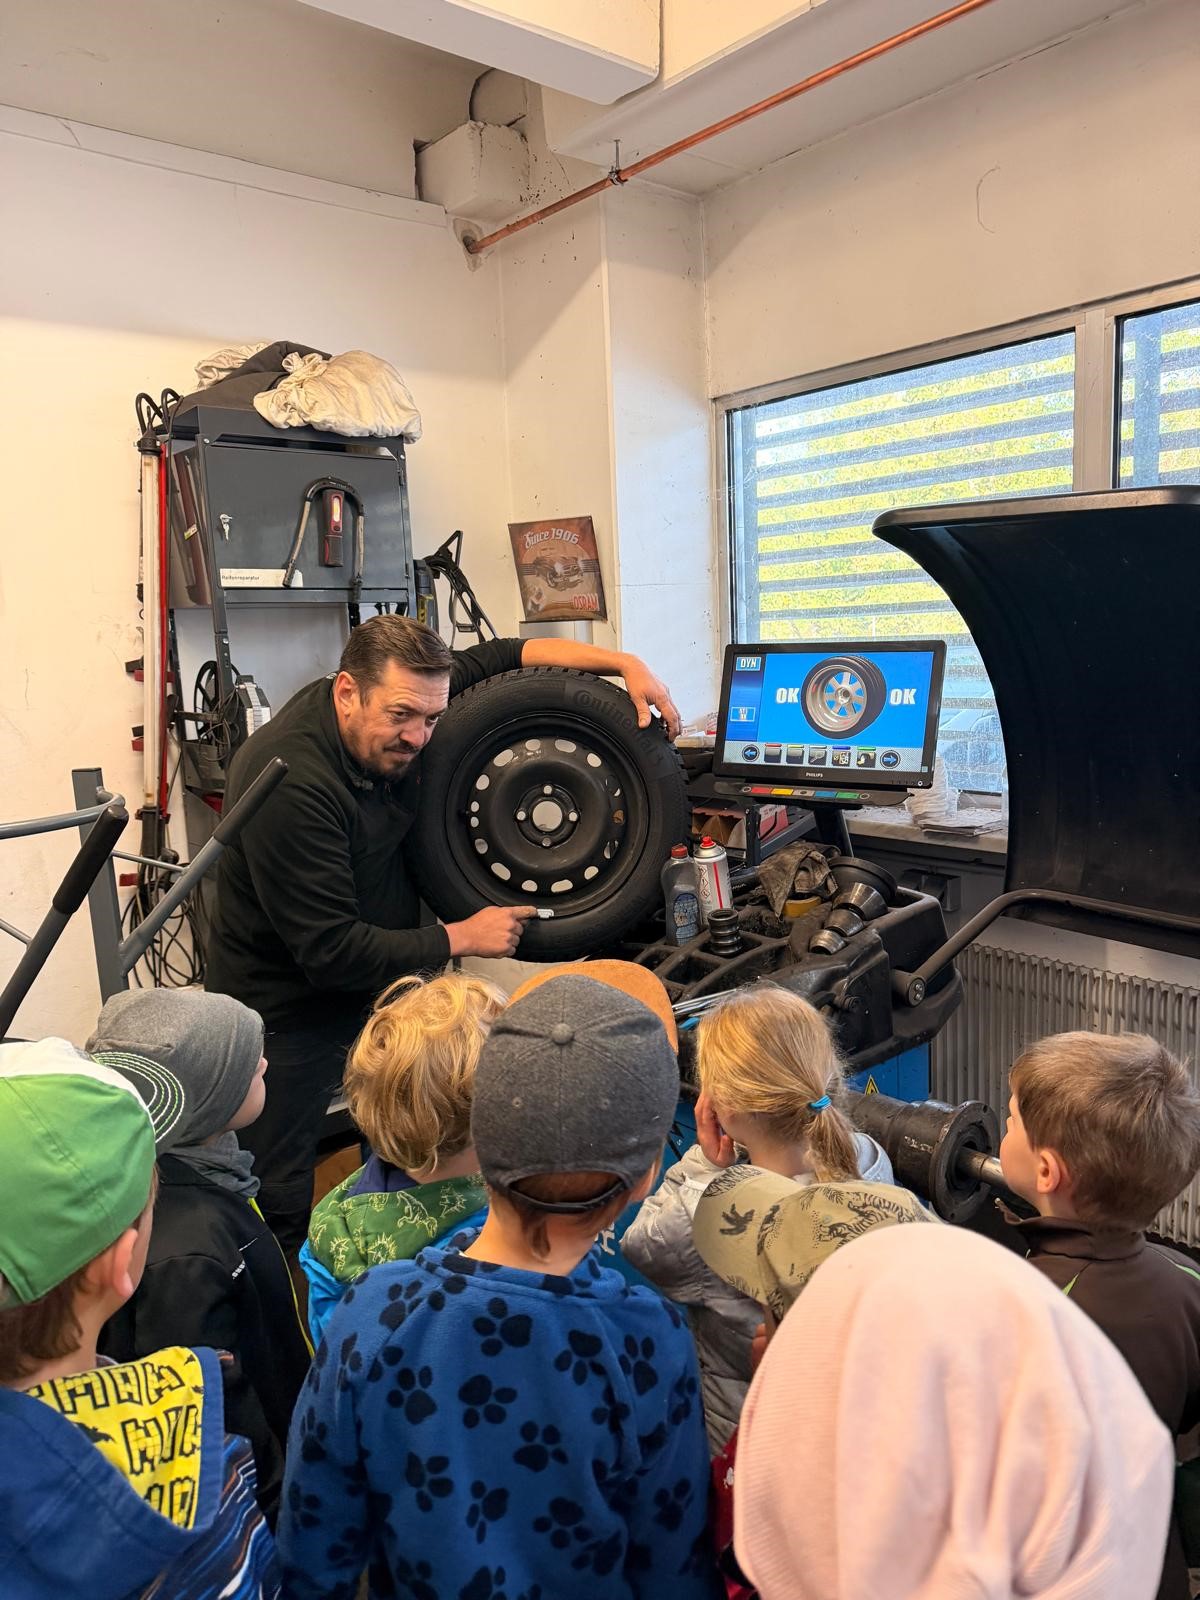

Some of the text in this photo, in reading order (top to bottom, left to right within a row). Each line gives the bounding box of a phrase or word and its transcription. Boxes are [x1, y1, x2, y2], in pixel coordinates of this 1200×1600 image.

[523, 527, 580, 549] Since 1906
[740, 658, 756, 668] DYN
[776, 687, 917, 705] OK OK
